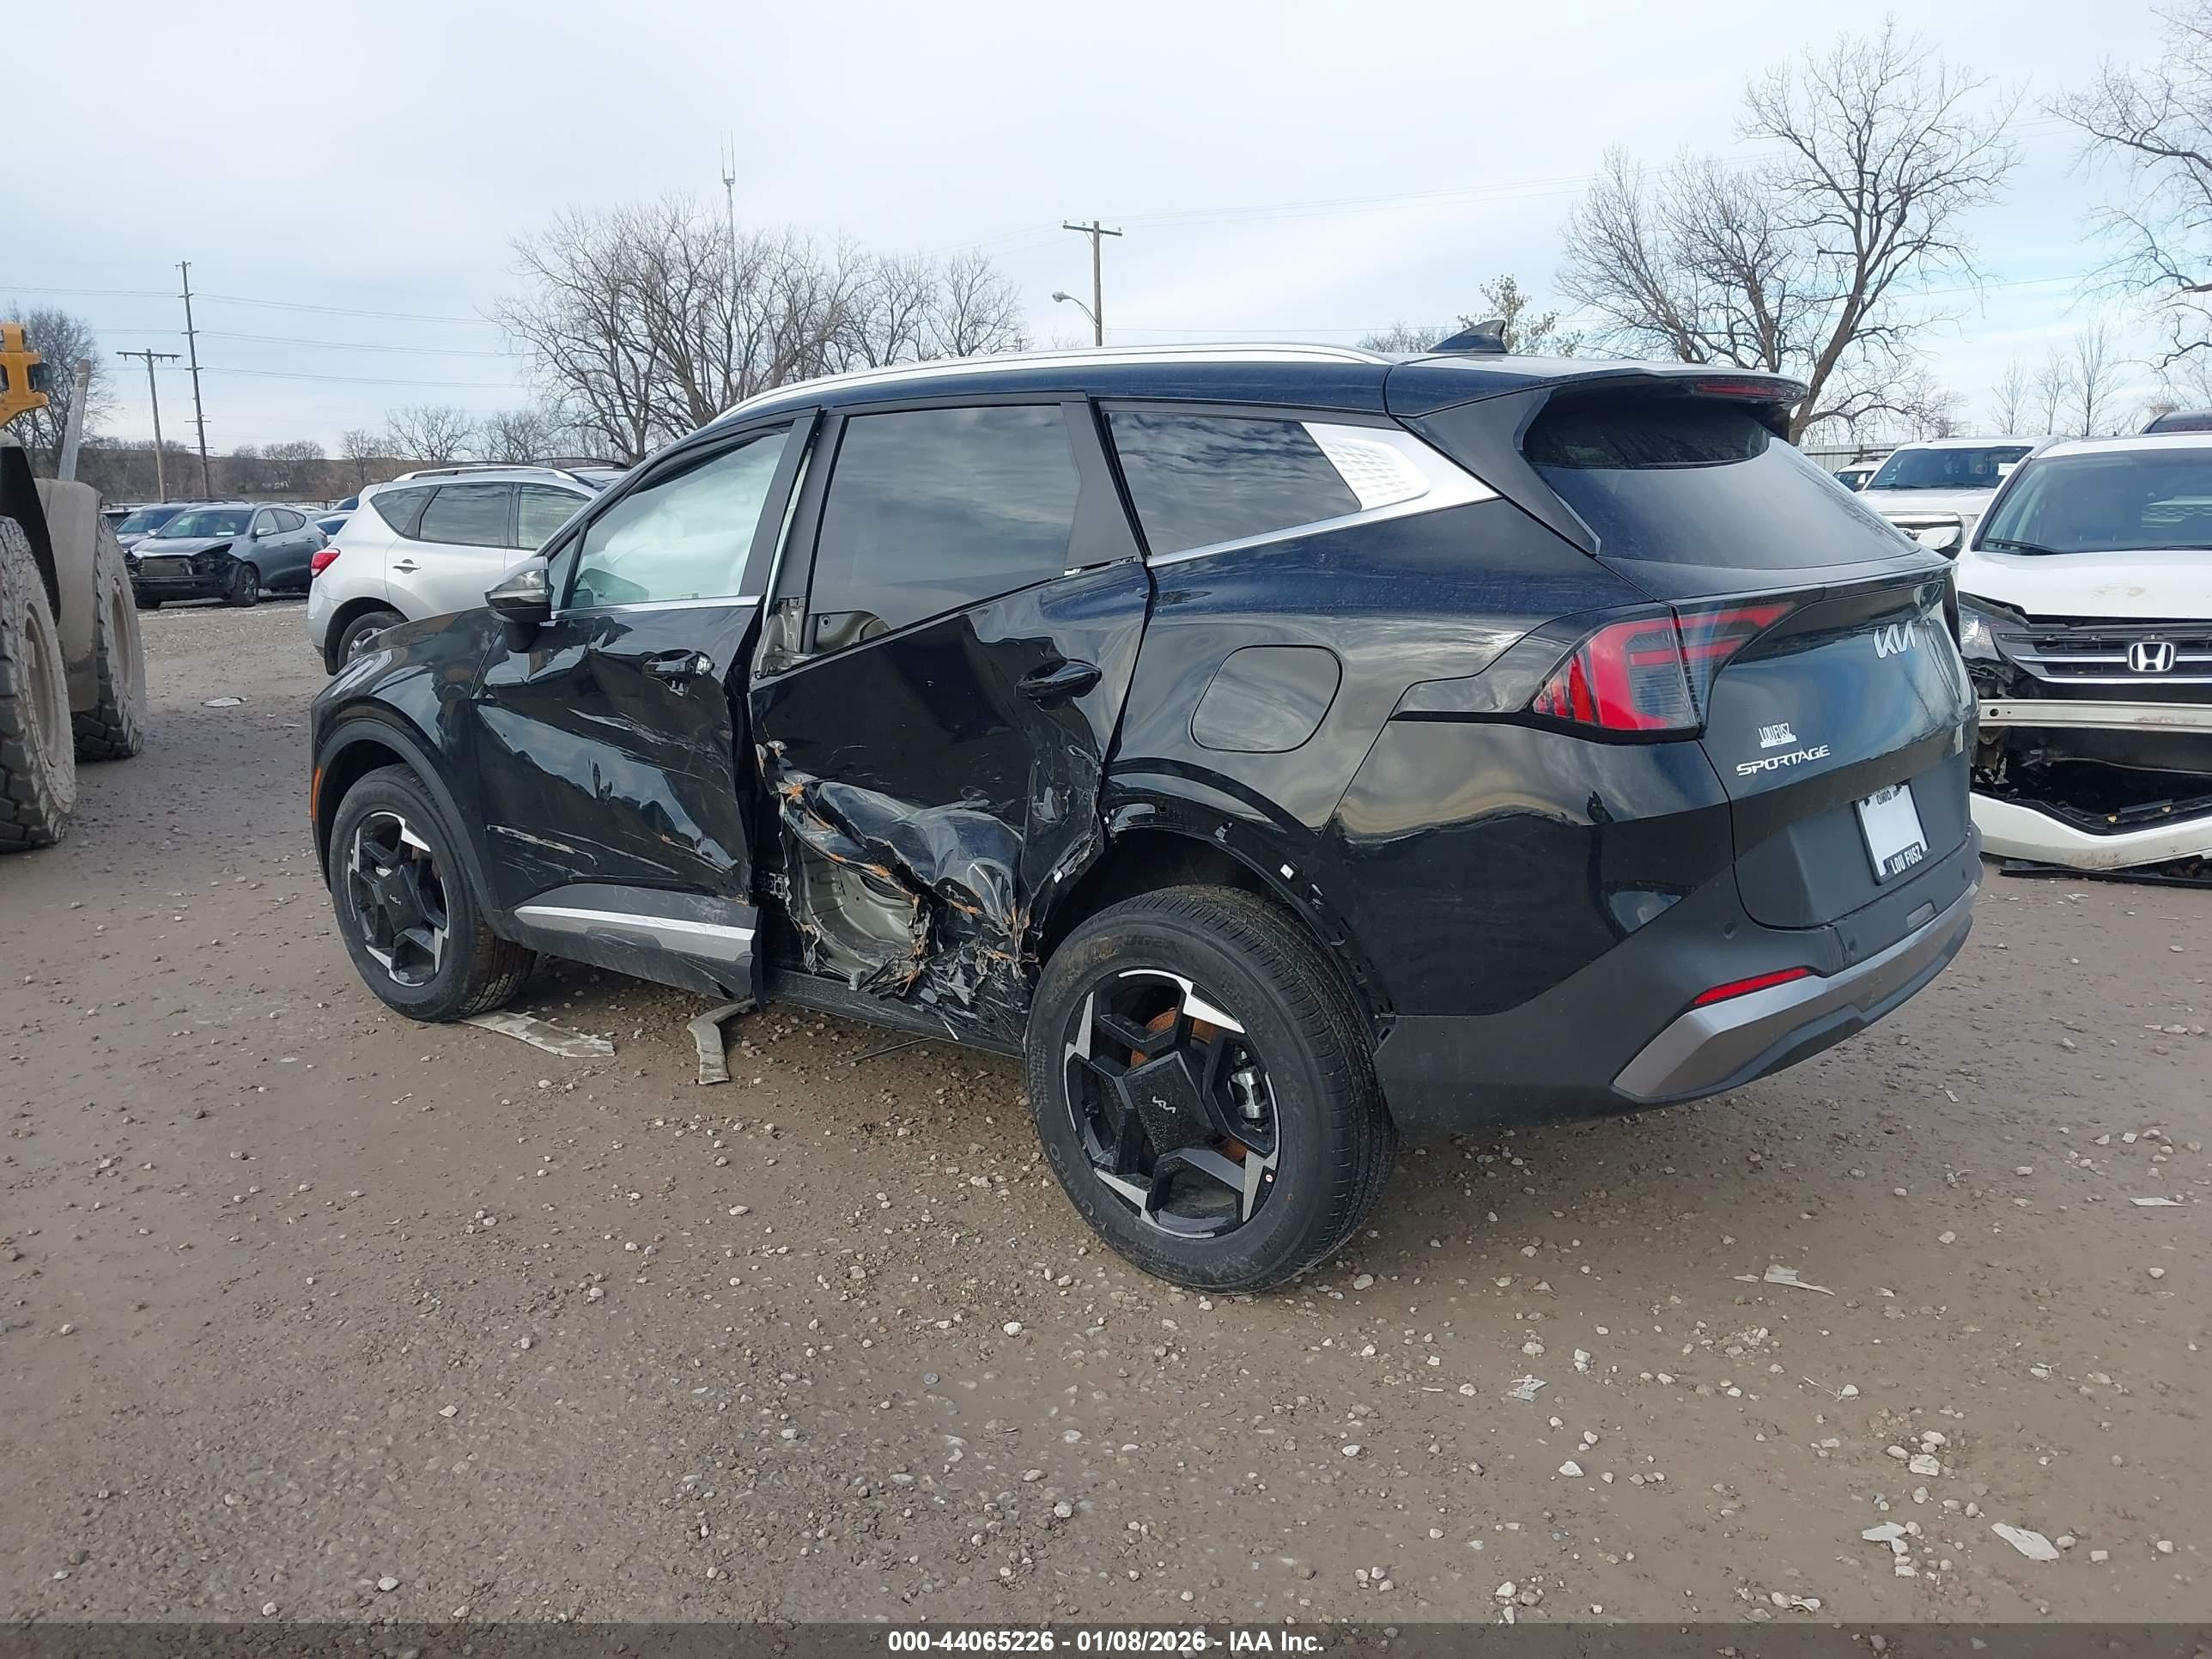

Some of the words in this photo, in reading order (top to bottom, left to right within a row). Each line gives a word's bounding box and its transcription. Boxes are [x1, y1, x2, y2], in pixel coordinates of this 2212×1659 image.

[1736, 744, 1831, 776] SPORTAGE
[1875, 790, 1893, 805] OHIO
[1890, 854, 1906, 875] LOU
[1904, 844, 1923, 866] FUSZ
